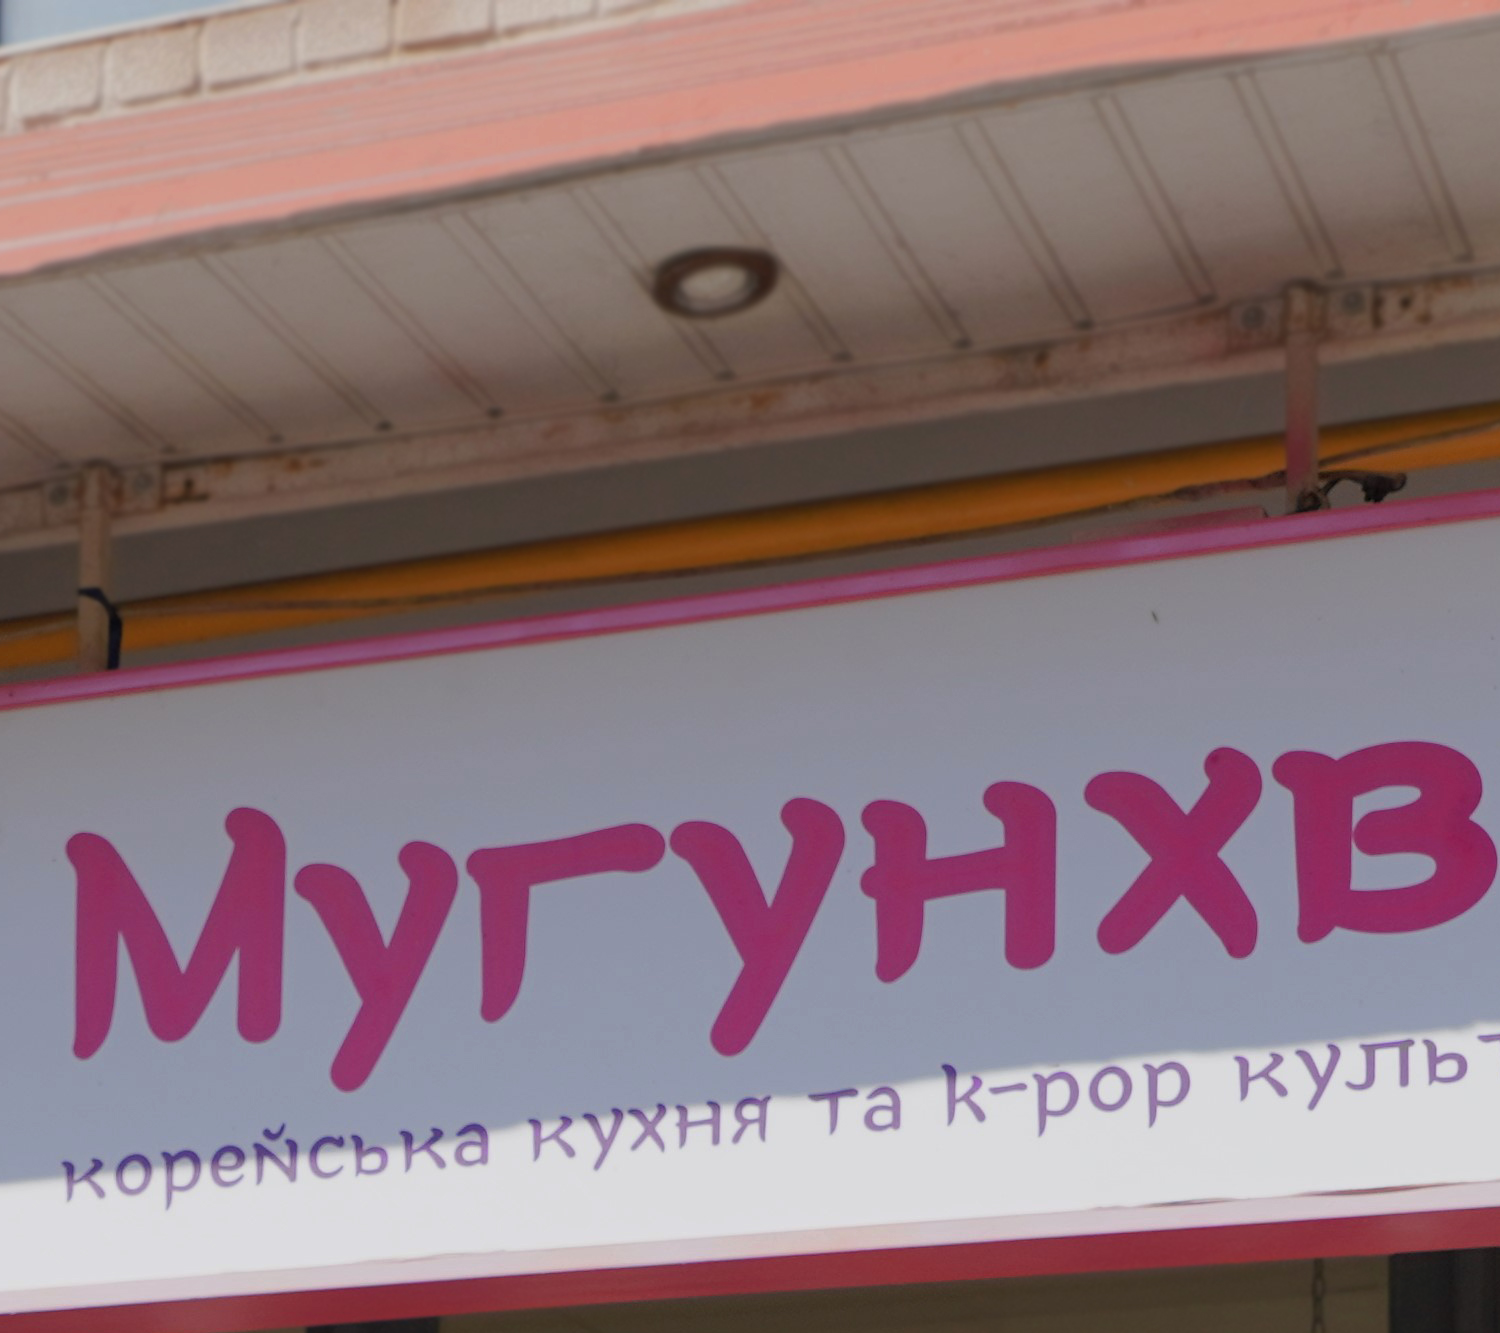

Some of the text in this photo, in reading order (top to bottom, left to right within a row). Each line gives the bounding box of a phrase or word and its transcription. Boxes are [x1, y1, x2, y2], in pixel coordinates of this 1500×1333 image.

[60, 1122, 490, 1211] корейська
[527, 1094, 772, 1172] кухня
[807, 1086, 902, 1136] та
[940, 1063, 1191, 1137] k-pop
